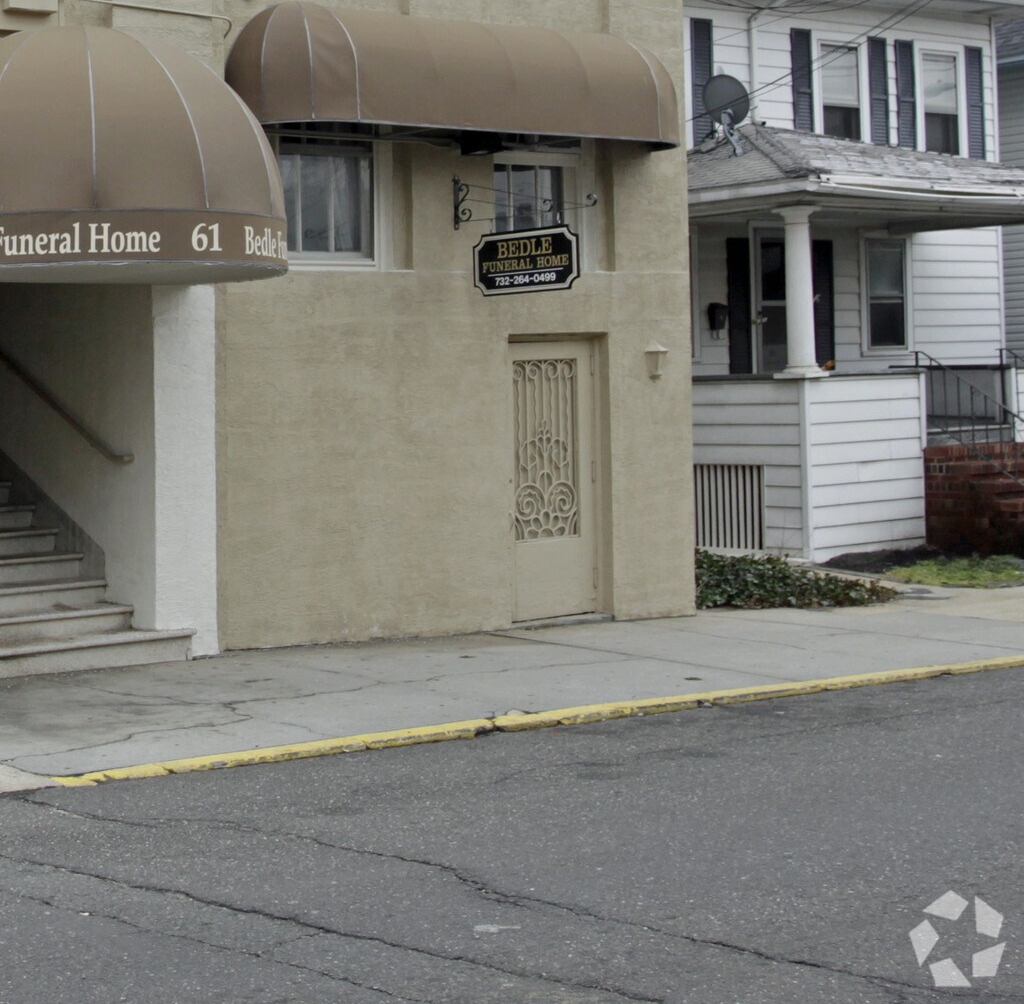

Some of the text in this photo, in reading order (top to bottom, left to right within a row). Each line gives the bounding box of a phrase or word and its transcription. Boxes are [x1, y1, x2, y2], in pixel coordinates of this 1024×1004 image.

[88, 223, 161, 254] Home
[191, 223, 223, 252] 61
[244, 225, 277, 259] Bedle
[497, 237, 553, 259] BEDLE
[482, 254, 569, 274] FUNERAL HOME
[495, 272, 556, 286] 732-264-0499
